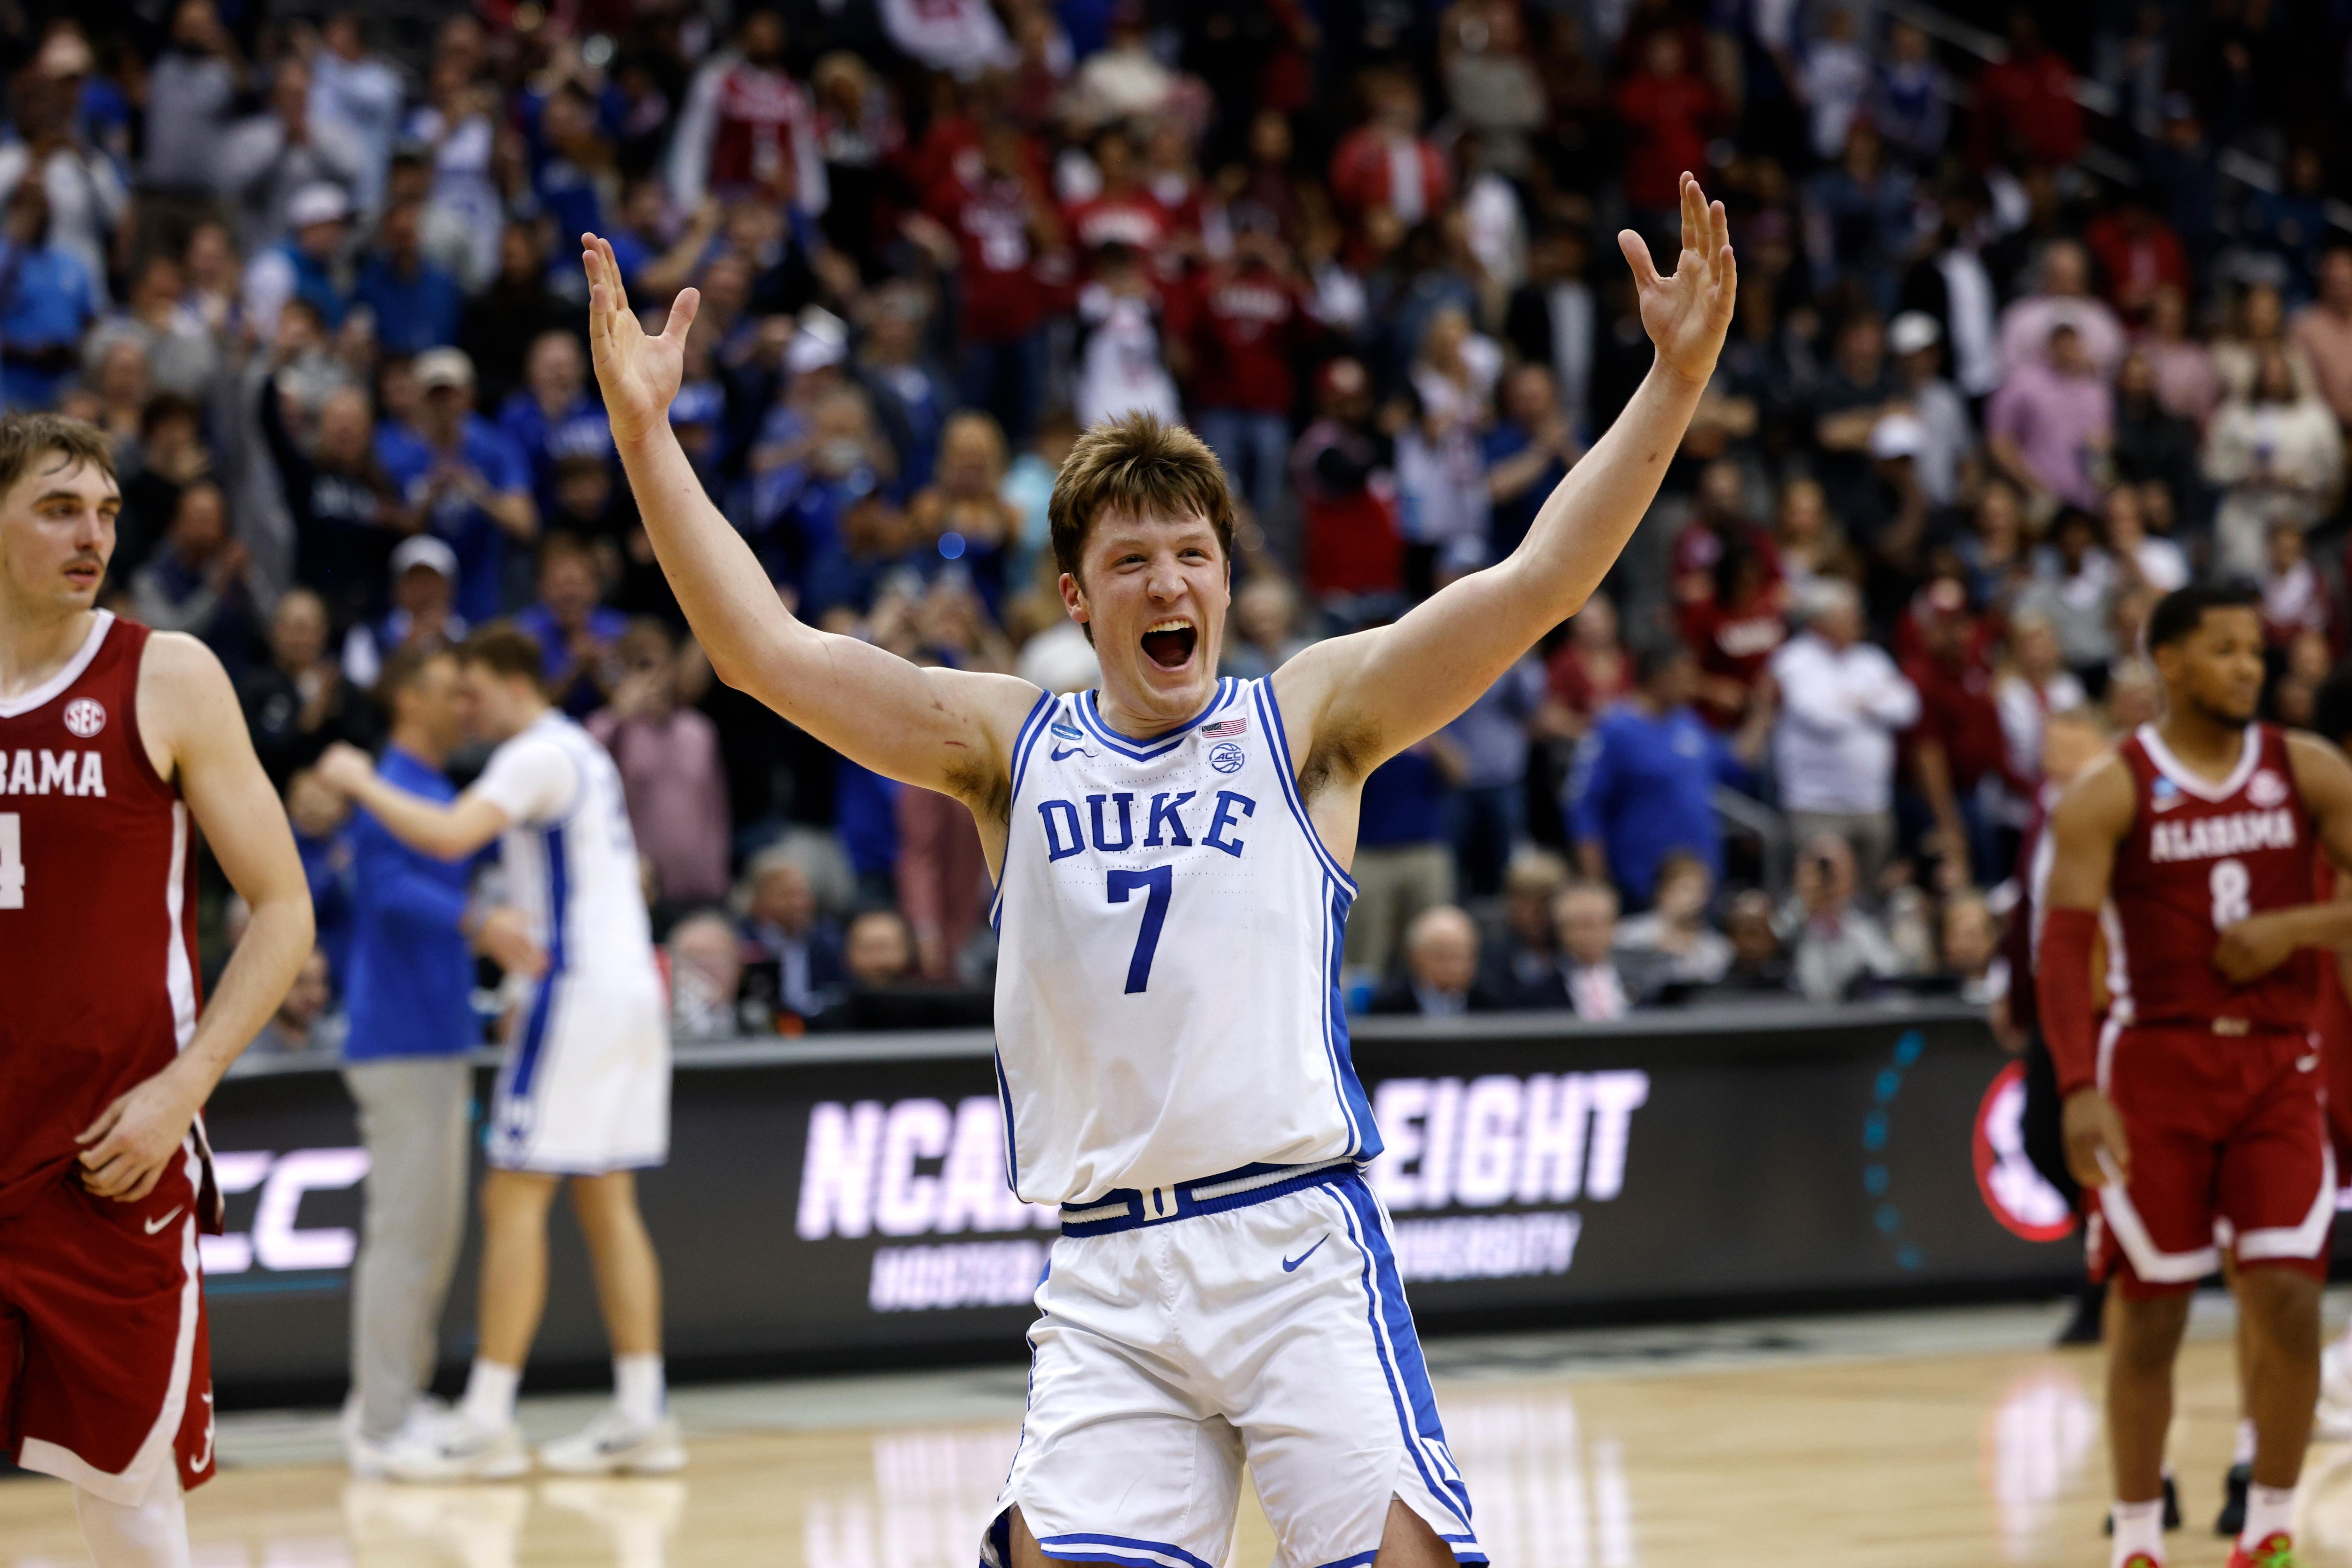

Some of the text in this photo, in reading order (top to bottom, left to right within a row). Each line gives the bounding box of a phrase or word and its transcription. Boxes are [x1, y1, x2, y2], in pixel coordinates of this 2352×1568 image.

[67, 700, 103, 735] SEC
[1214, 751, 1242, 760] ACC
[1038, 790, 1256, 863] DUKE
[2150, 808, 2296, 863] ALABAMA
[1107, 865, 1172, 995] 7
[797, 1069, 1650, 1241] NCA EIGHT
